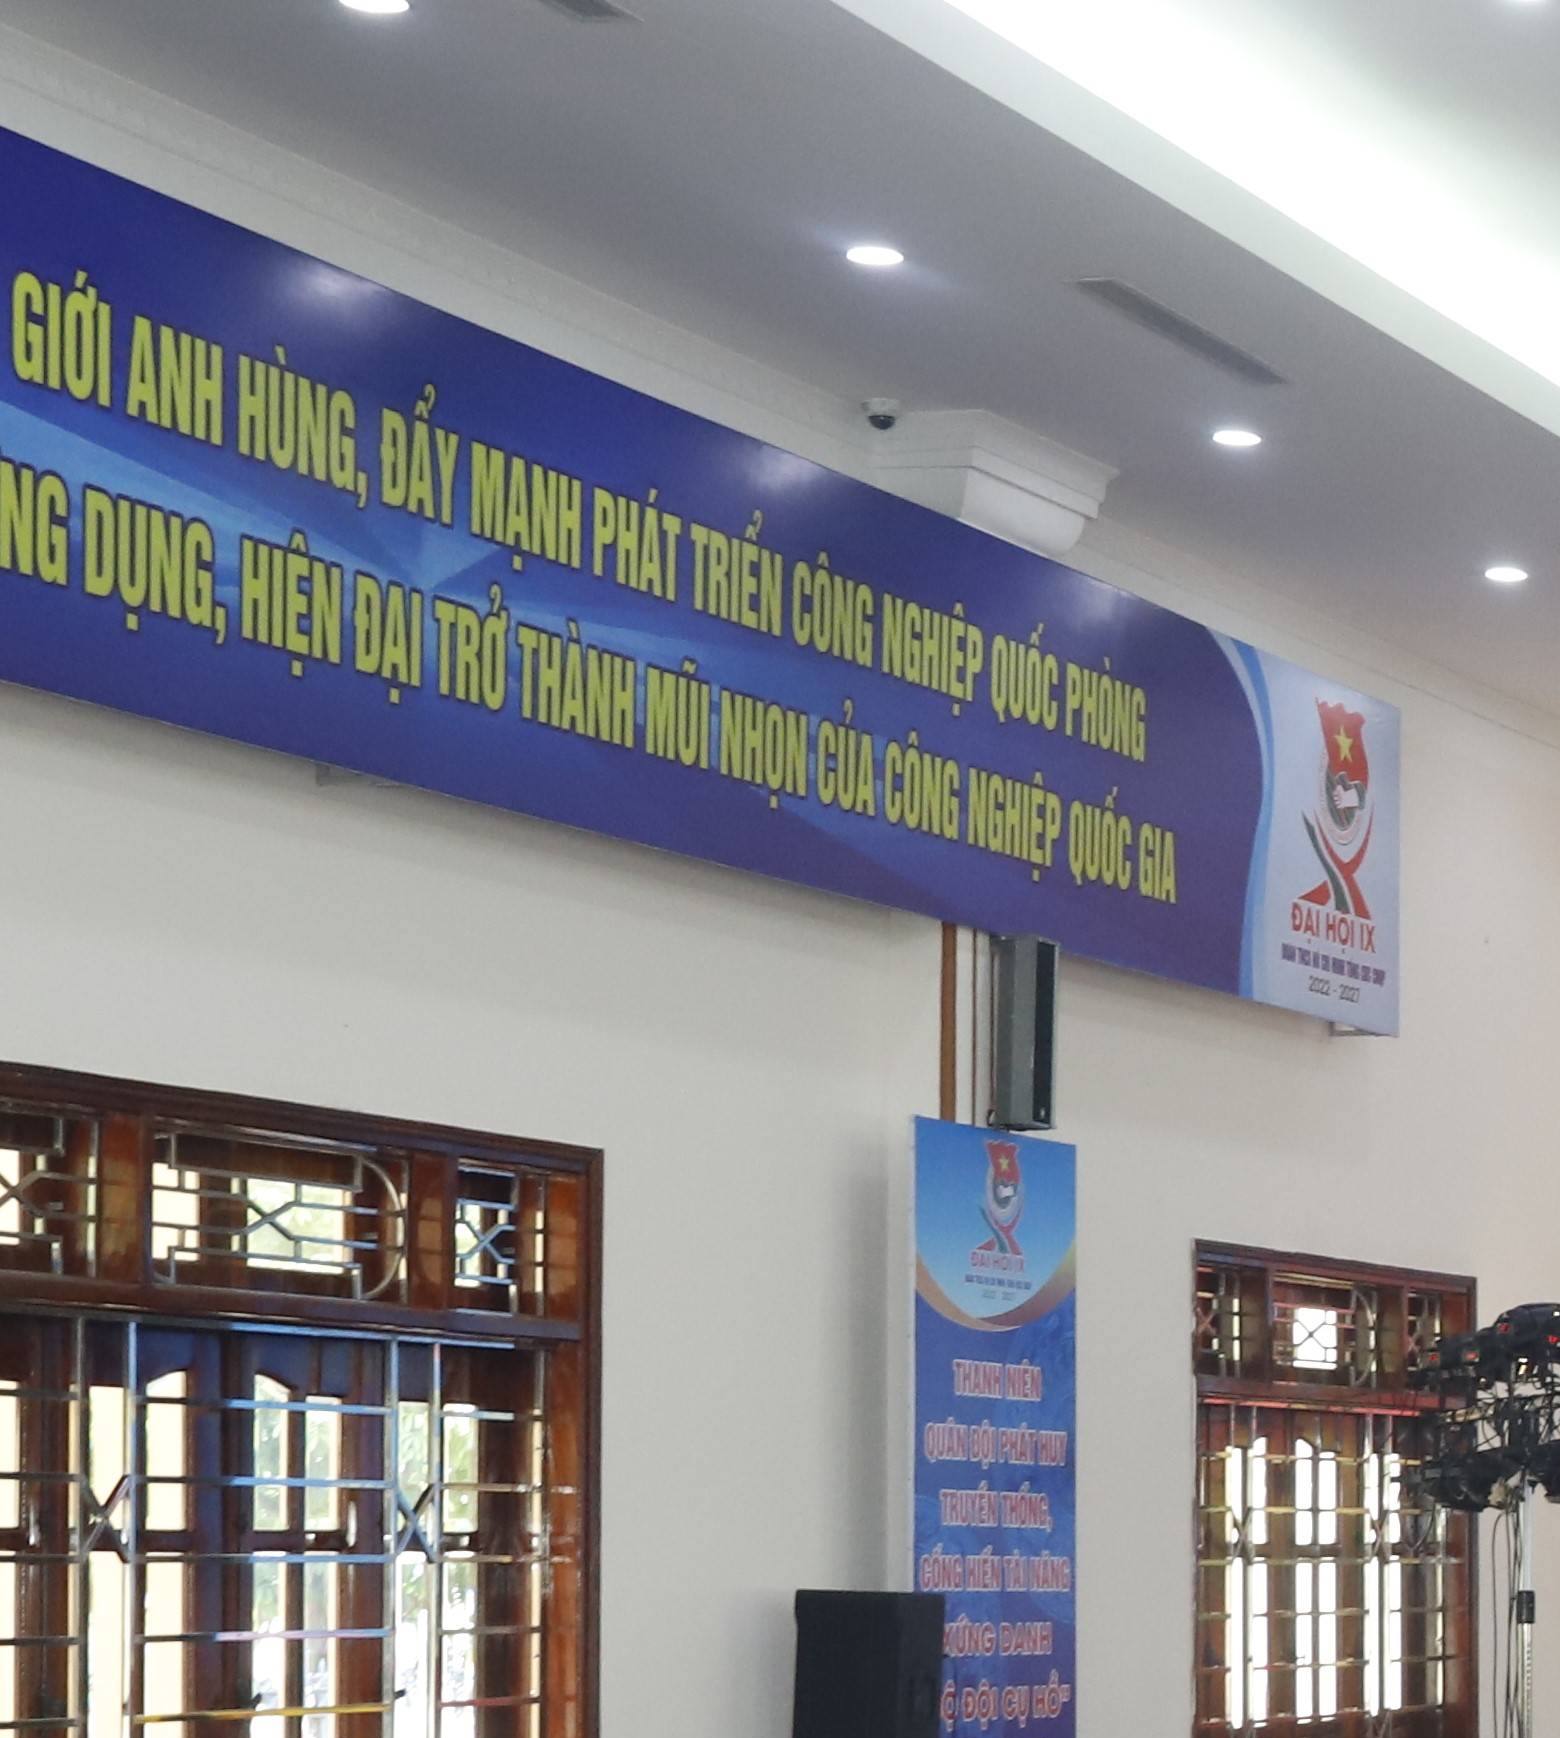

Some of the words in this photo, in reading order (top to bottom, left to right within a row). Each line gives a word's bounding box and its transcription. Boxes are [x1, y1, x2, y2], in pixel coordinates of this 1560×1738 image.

[12, 270, 111, 408] GIỚI
[126, 315, 224, 447] ANH
[237, 345, 369, 508] HÙNG,
[380, 383, 459, 529] ĐẨY
[470, 441, 581, 571] MẠNH
[593, 489, 681, 602] PHÁT
[690, 509, 782, 637] TRIỂN
[792, 552, 874, 667] CÔNG
[882, 602, 983, 716] NGHIỆP
[991, 623, 1058, 731] QUỐC
[1066, 657, 1146, 761] PHÒNG
[83, 487, 227, 644] DỤNG,
[240, 529, 342, 676] HIỆN
[354, 571, 422, 704] ĐẠI
[434, 583, 508, 711] TRỞ
[517, 618, 635, 748] THÀNH
[645, 658, 710, 769] MŨI
[719, 688, 808, 808] NHỌN
[817, 699, 875, 816] CỦA
[884, 731, 959, 840] CÔNG
[967, 771, 1061, 881] NGHIỆP
[1068, 786, 1131, 890] QUỐC
[1139, 822, 1176, 903] GIA
[1292, 902, 1319, 944] ĐẠI
[1326, 910, 1354, 954] HỘI
[1360, 923, 1376, 953] IX
[953, 1360, 1002, 1399] THANH
[1005, 1359, 1041, 1401] NIÊN
